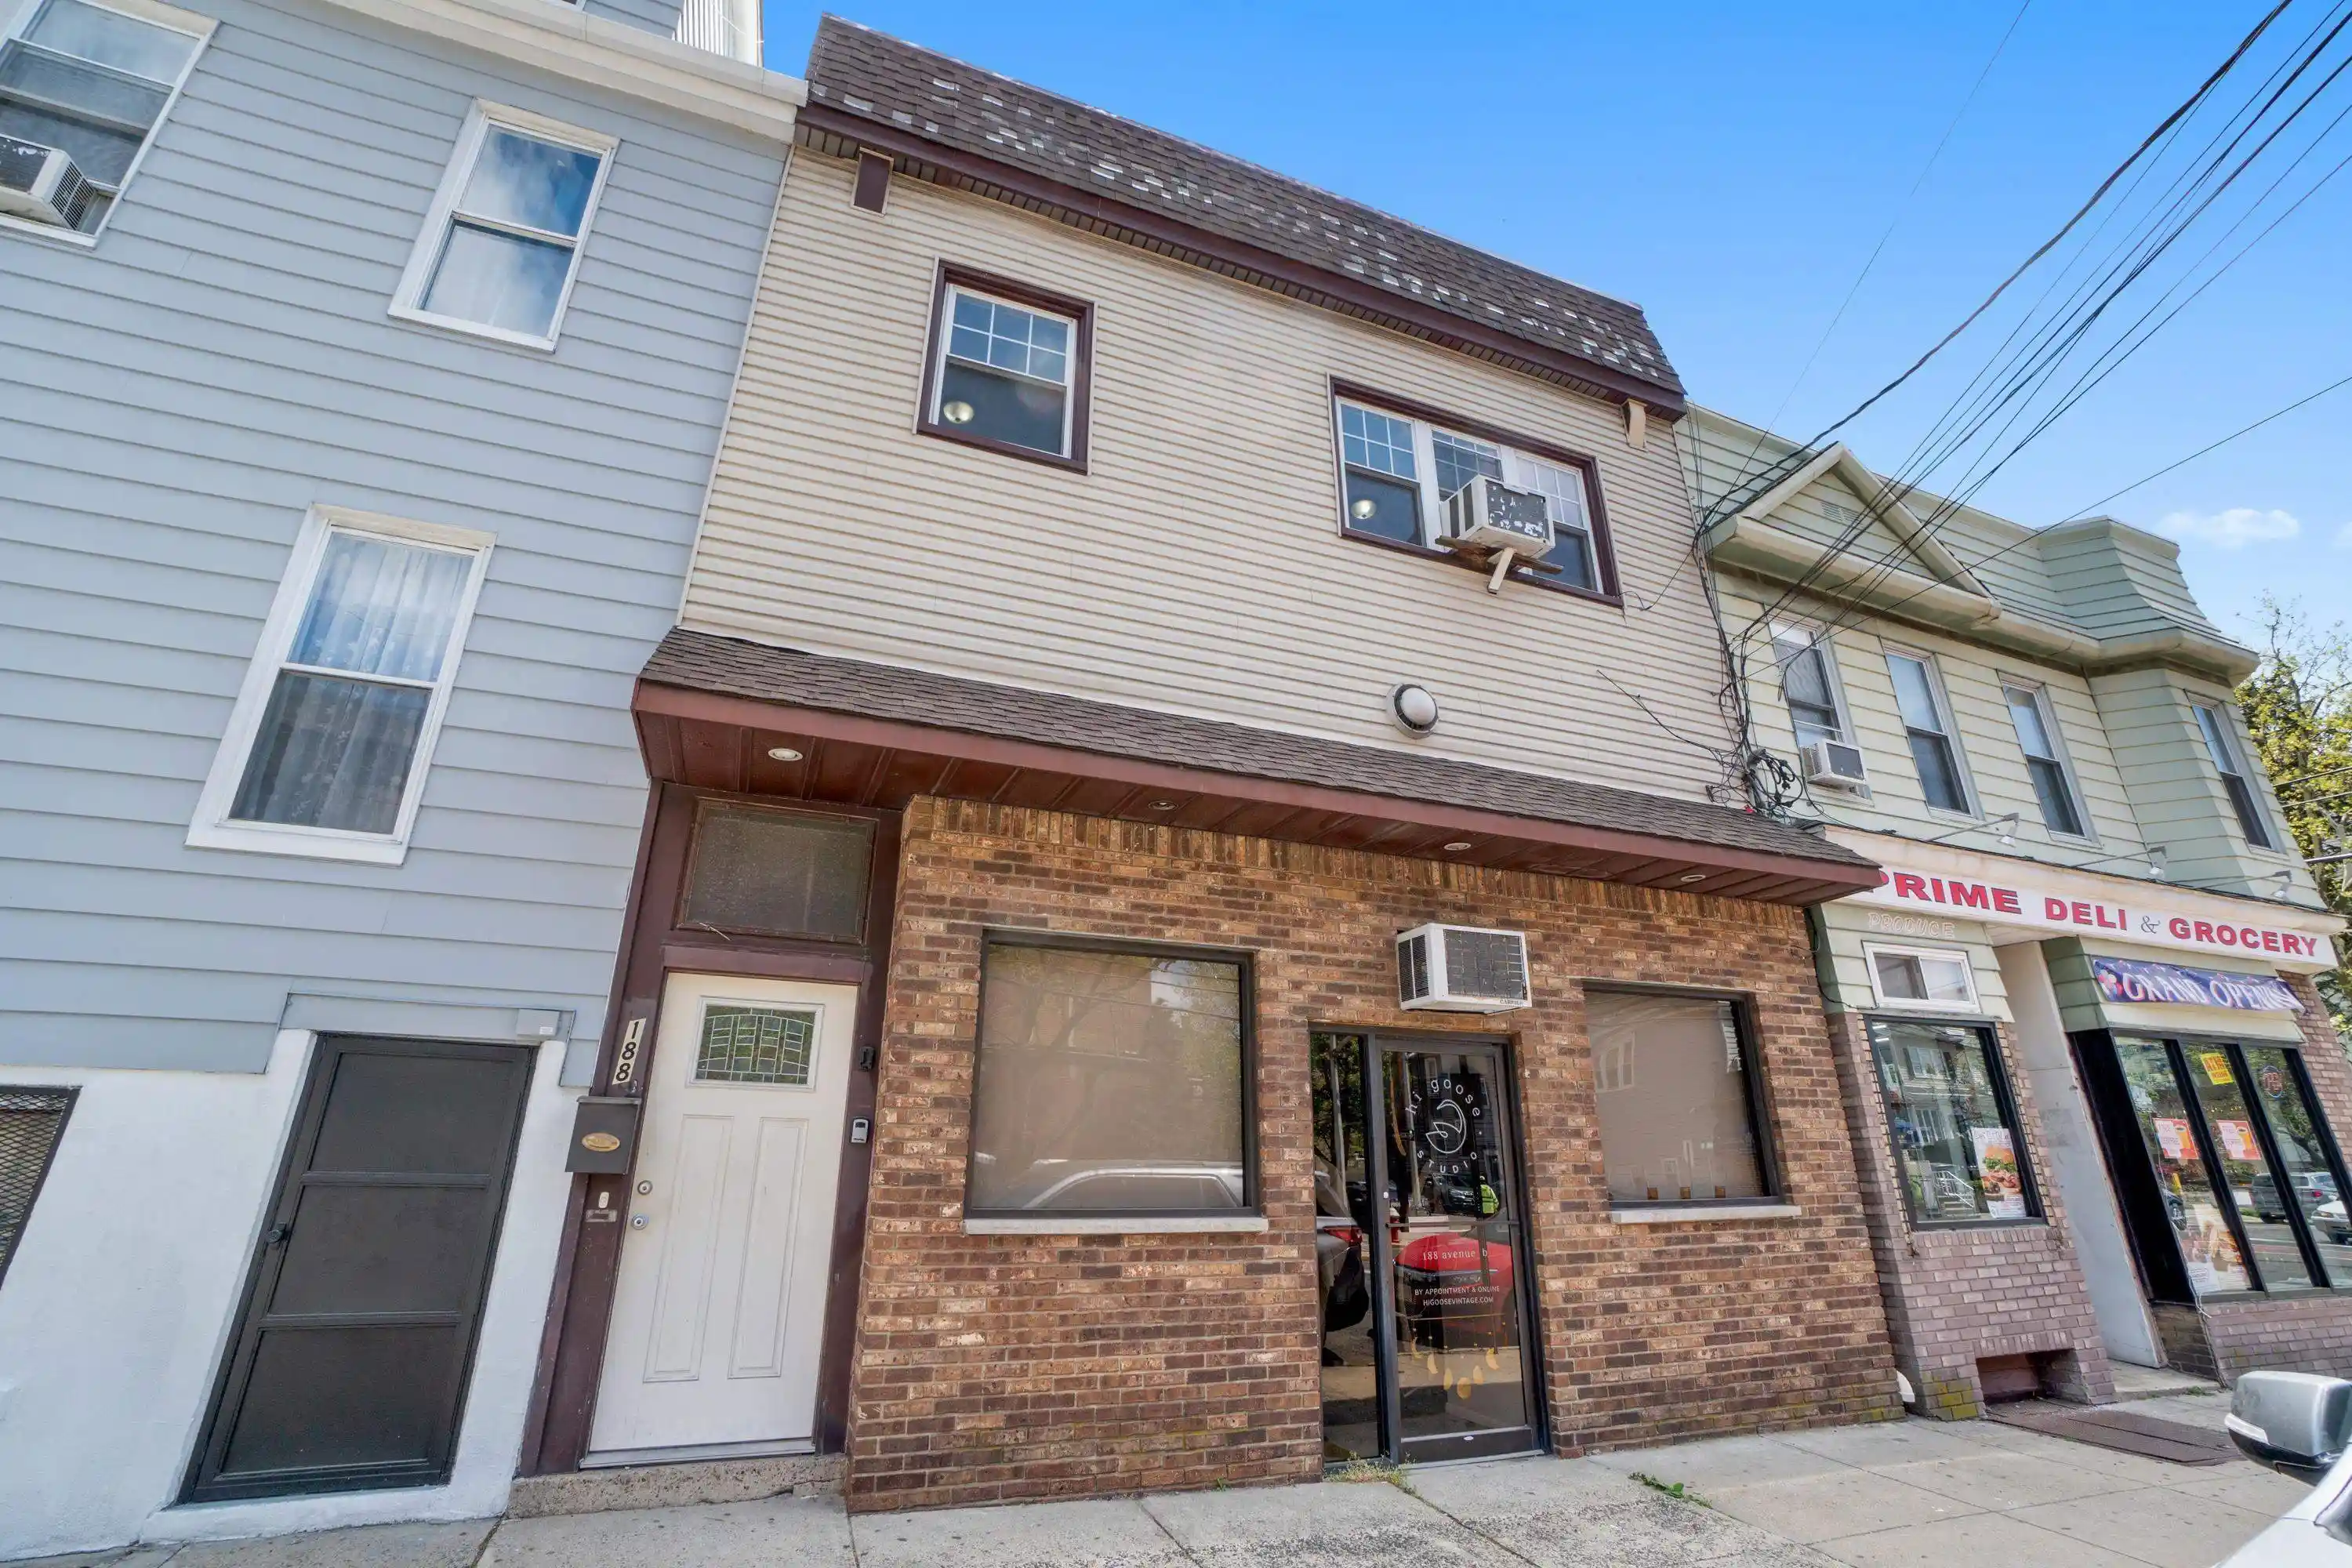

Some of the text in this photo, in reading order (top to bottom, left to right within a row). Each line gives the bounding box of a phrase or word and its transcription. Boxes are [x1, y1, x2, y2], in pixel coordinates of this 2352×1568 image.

[1867, 912, 1956, 938] PRODUCE
[2045, 897, 2128, 931] DELI
[2141, 916, 2161, 934] &
[2169, 918, 2318, 956] GROCERY
[2122, 972, 2211, 1004] GRAND
[615, 1021, 640, 1082] 188
[1405, 1079, 1481, 1116] hi goose
[1417, 1150, 1477, 1174] STUDIO
[1423, 1247, 1488, 1261] 188 avenue b
[1423, 1297, 1494, 1306] HIGOOSEVINTAGE.COM
[1425, 1287, 1470, 1295] APPOINTMENT
